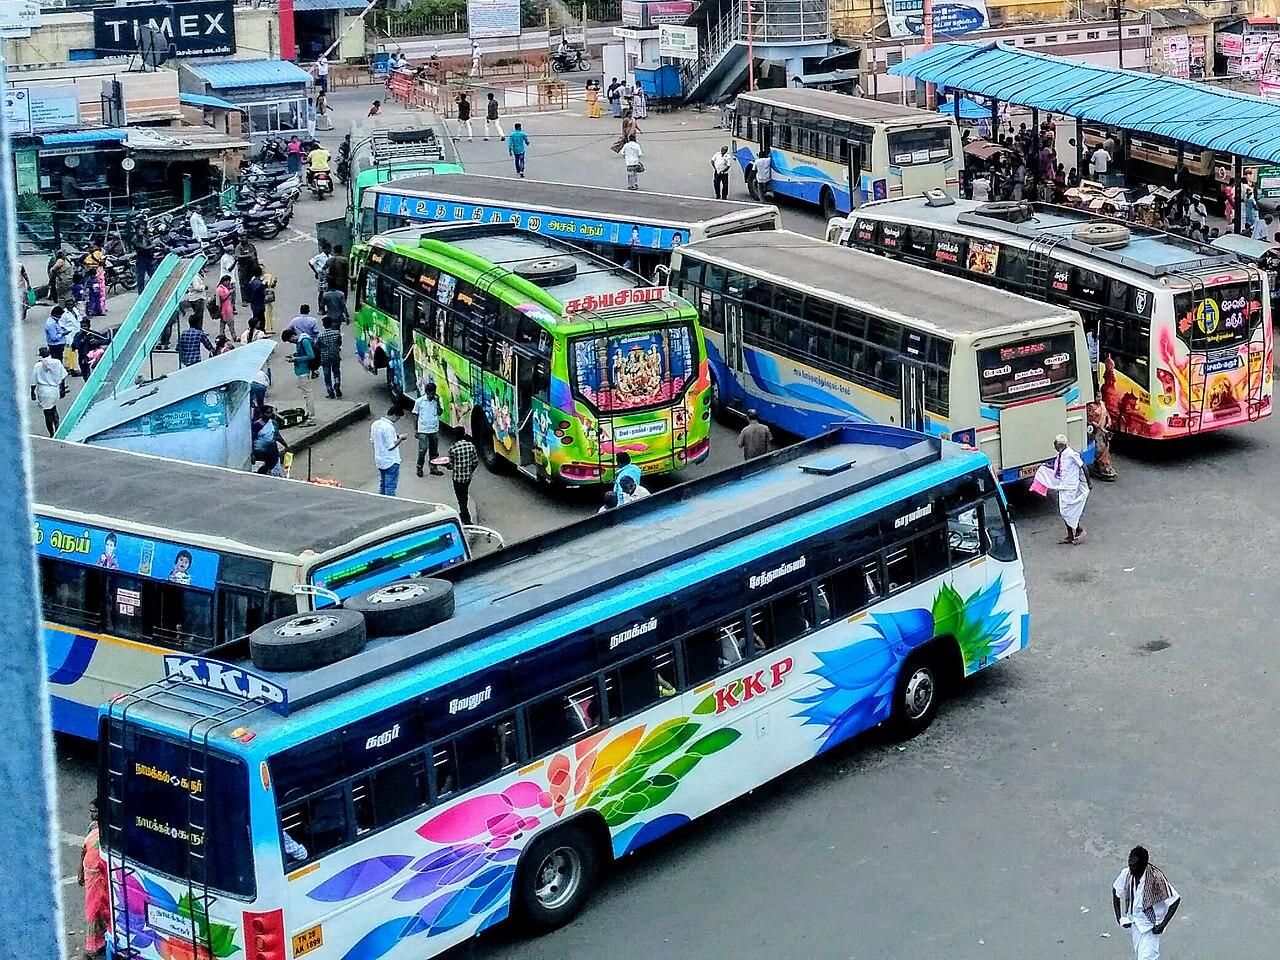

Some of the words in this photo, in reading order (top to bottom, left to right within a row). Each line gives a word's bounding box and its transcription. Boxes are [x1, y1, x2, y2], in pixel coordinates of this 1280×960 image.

[104, 12, 226, 42] TIMEX
[547, 220, 577, 234] அசல்
[579, 221, 604, 237] நெய்
[50, 529, 92, 555] நெய்
[609, 616, 658, 650] நாமக்கல்
[448, 685, 492, 715] வேலூர்
[365, 723, 401, 749] கரூர்
[135, 762, 170, 784] நாமக்கல்
[135, 815, 171, 836] நாமக்கல்
